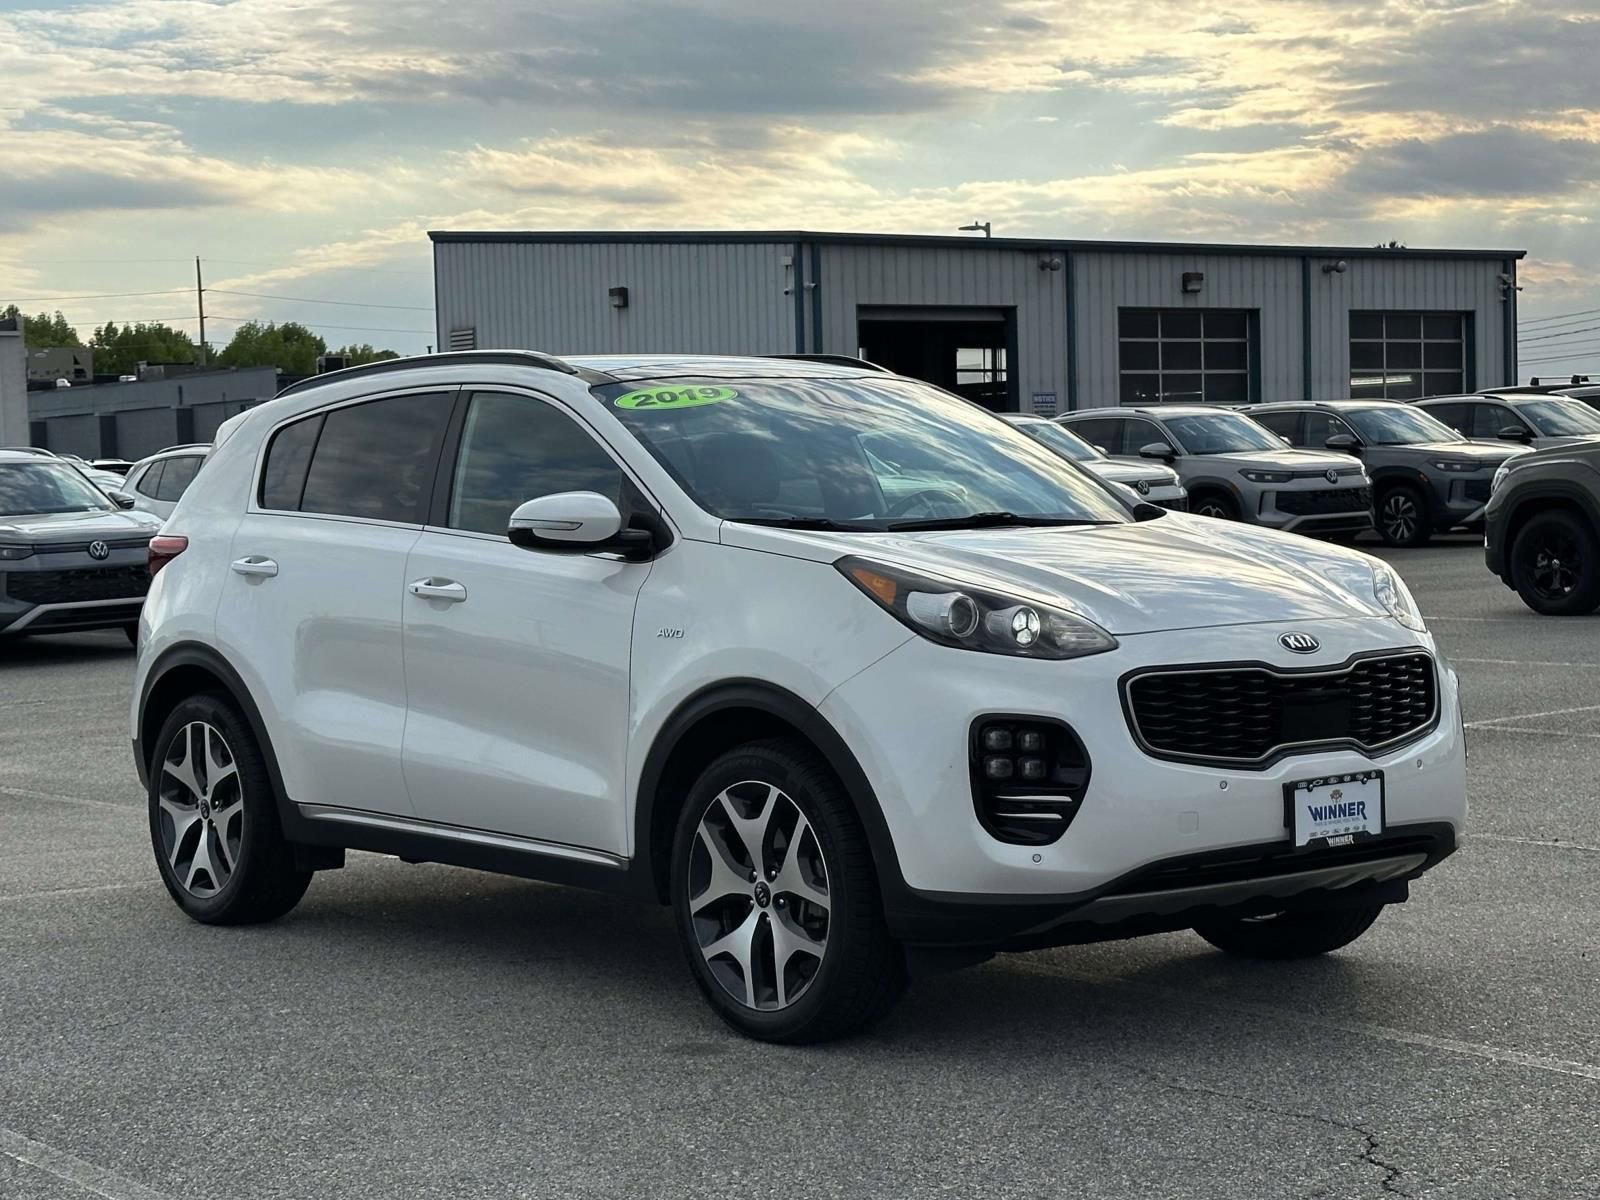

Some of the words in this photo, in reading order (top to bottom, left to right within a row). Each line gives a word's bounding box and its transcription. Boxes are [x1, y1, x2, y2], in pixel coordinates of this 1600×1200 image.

[632, 387, 721, 407] 2019
[656, 628, 685, 639] AWD
[1284, 634, 1318, 649] KIA
[1308, 801, 1368, 822] WINNER
[1326, 834, 1354, 848] WINNER
